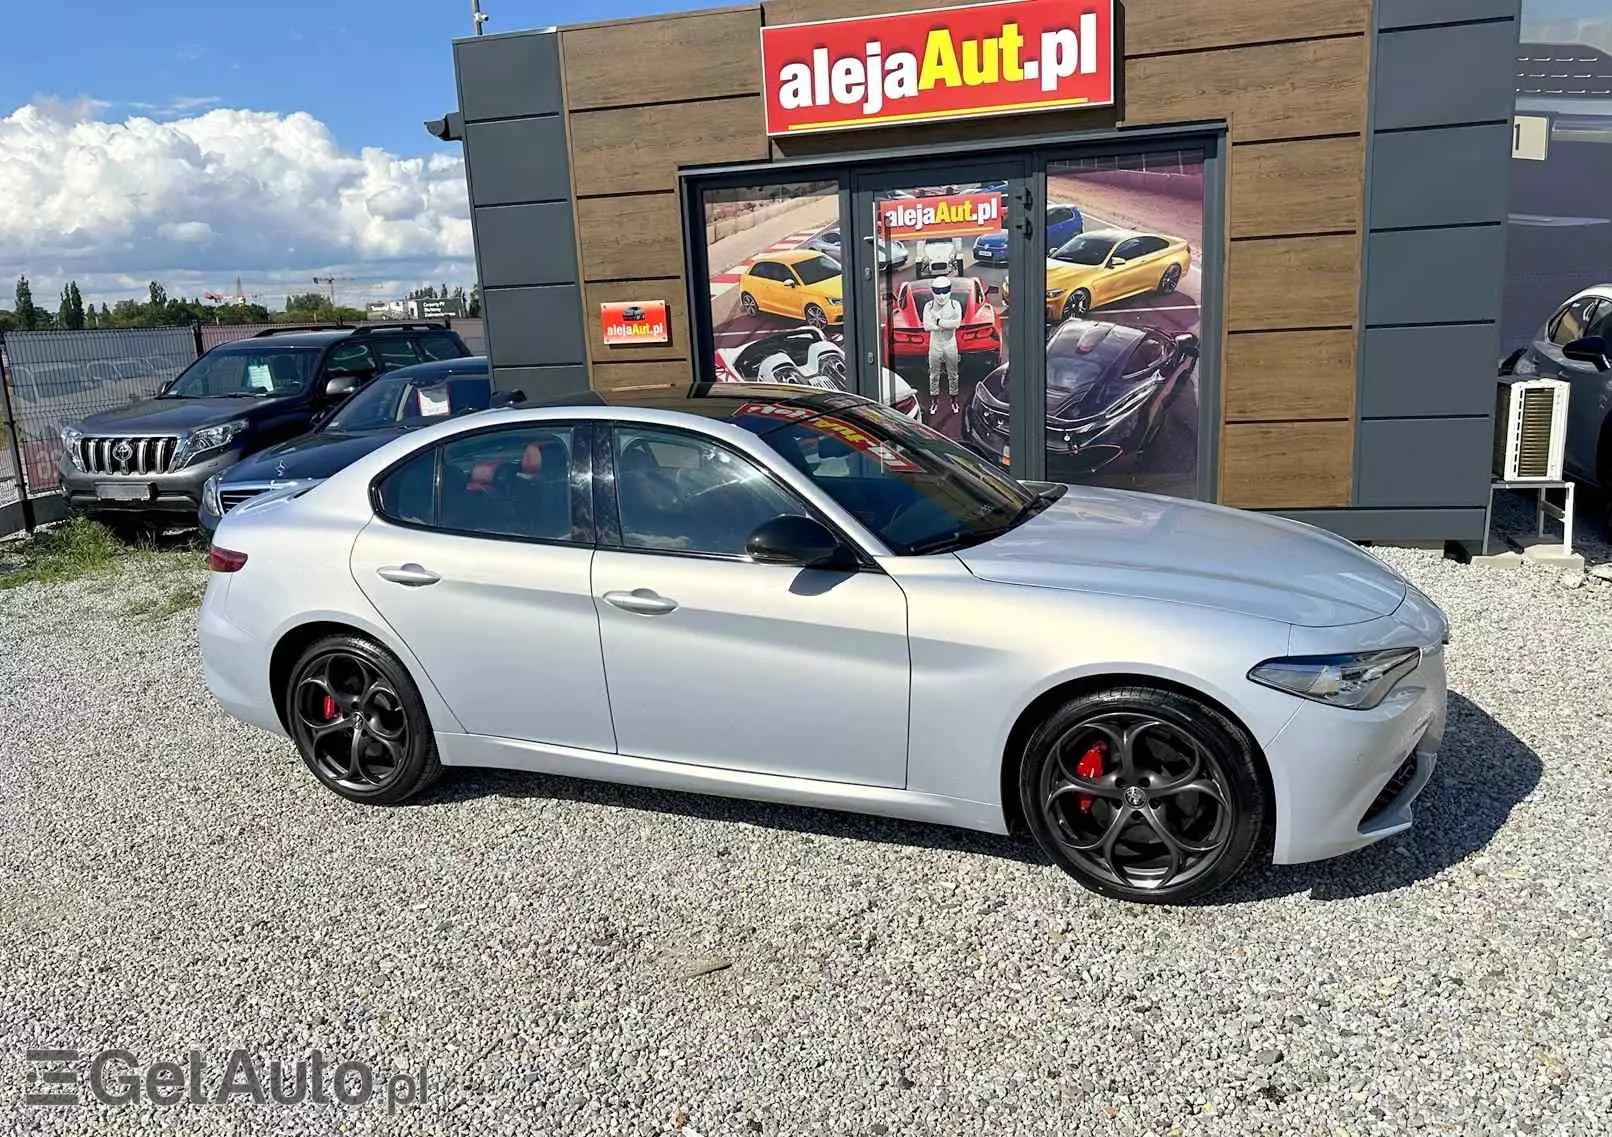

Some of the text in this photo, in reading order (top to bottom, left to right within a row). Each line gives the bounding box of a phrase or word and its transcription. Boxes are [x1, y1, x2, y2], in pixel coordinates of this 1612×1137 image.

[779, 13, 1097, 115] alejaAut.pl
[885, 198, 998, 229] alejaAut.pl
[607, 323, 663, 337] alejaAut.pl
